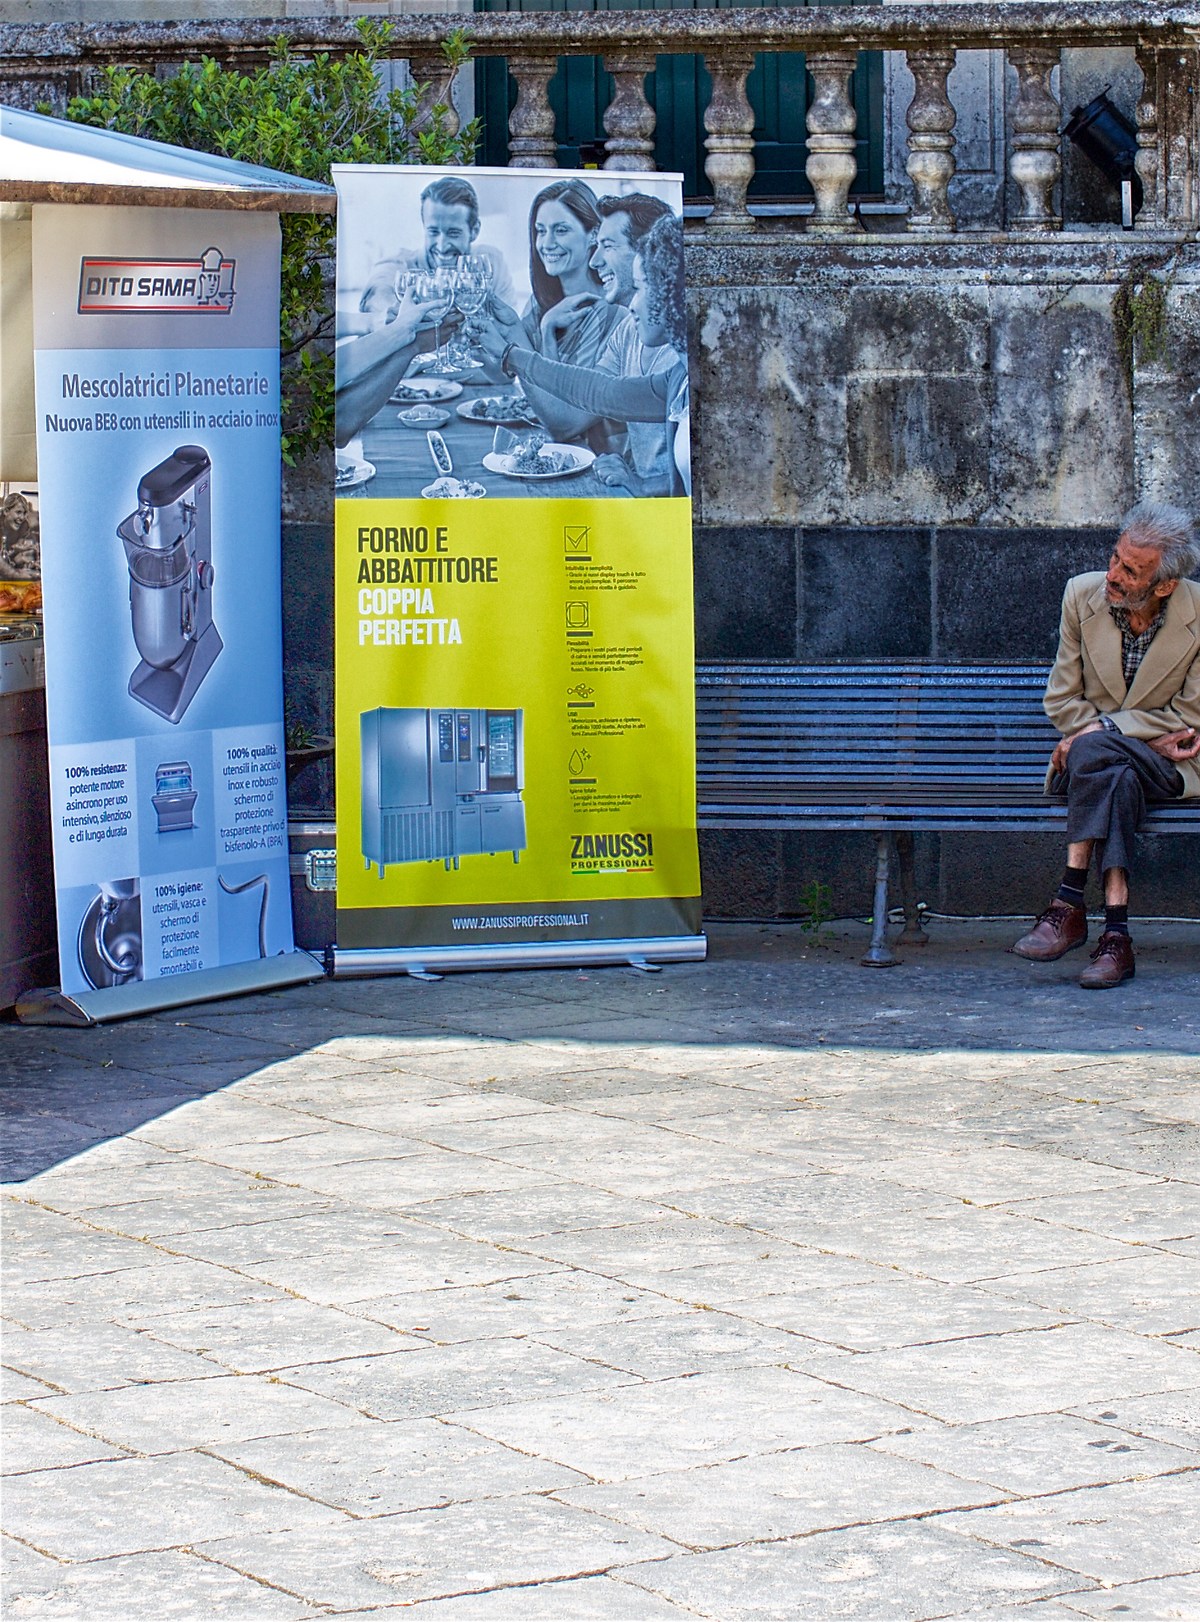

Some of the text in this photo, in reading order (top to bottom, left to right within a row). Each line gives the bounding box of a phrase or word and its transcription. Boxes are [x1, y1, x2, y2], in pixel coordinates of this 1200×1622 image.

[86, 277, 197, 297] DITO SAMA
[62, 372, 268, 398] Mescolatrici Planetarie
[46, 410, 278, 432] Nuova BE8 con utensili in acciaio inox
[358, 527, 448, 553] FORNO E
[357, 557, 498, 584] ABBATTITORE
[358, 588, 435, 615] COPPIA
[359, 618, 463, 646] PERFETTA
[227, 744, 278, 760] 100% qualità:
[65, 763, 127, 779] 100% resistenza:
[222, 760, 281, 776] utensili in acciaio
[69, 779, 125, 797] potente motore
[228, 776, 279, 791] inox e robusto
[66, 795, 128, 811] asincrono per uso
[234, 791, 274, 806] schermo di
[62, 809, 132, 828] intensivo, silenzioso
[235, 807, 274, 823] protezione
[69, 826, 127, 843] e di lunga durata
[220, 824, 262, 839] trasparente
[263, 821, 279, 834] privo
[571, 833, 654, 859] ZANUSSI
[571, 859, 654, 869] PROFESSIONAL
[154, 882, 204, 898] 100% igiene:
[152, 898, 207, 914] utensili, vasca e
[160, 912, 199, 929] schermo di
[452, 913, 589, 930] WWW.ZANUSSIPROFESSIONAL.IT
[161, 929, 199, 946] protezione
[162, 945, 199, 960] facilmente
[160, 960, 204, 976] smontabili e
